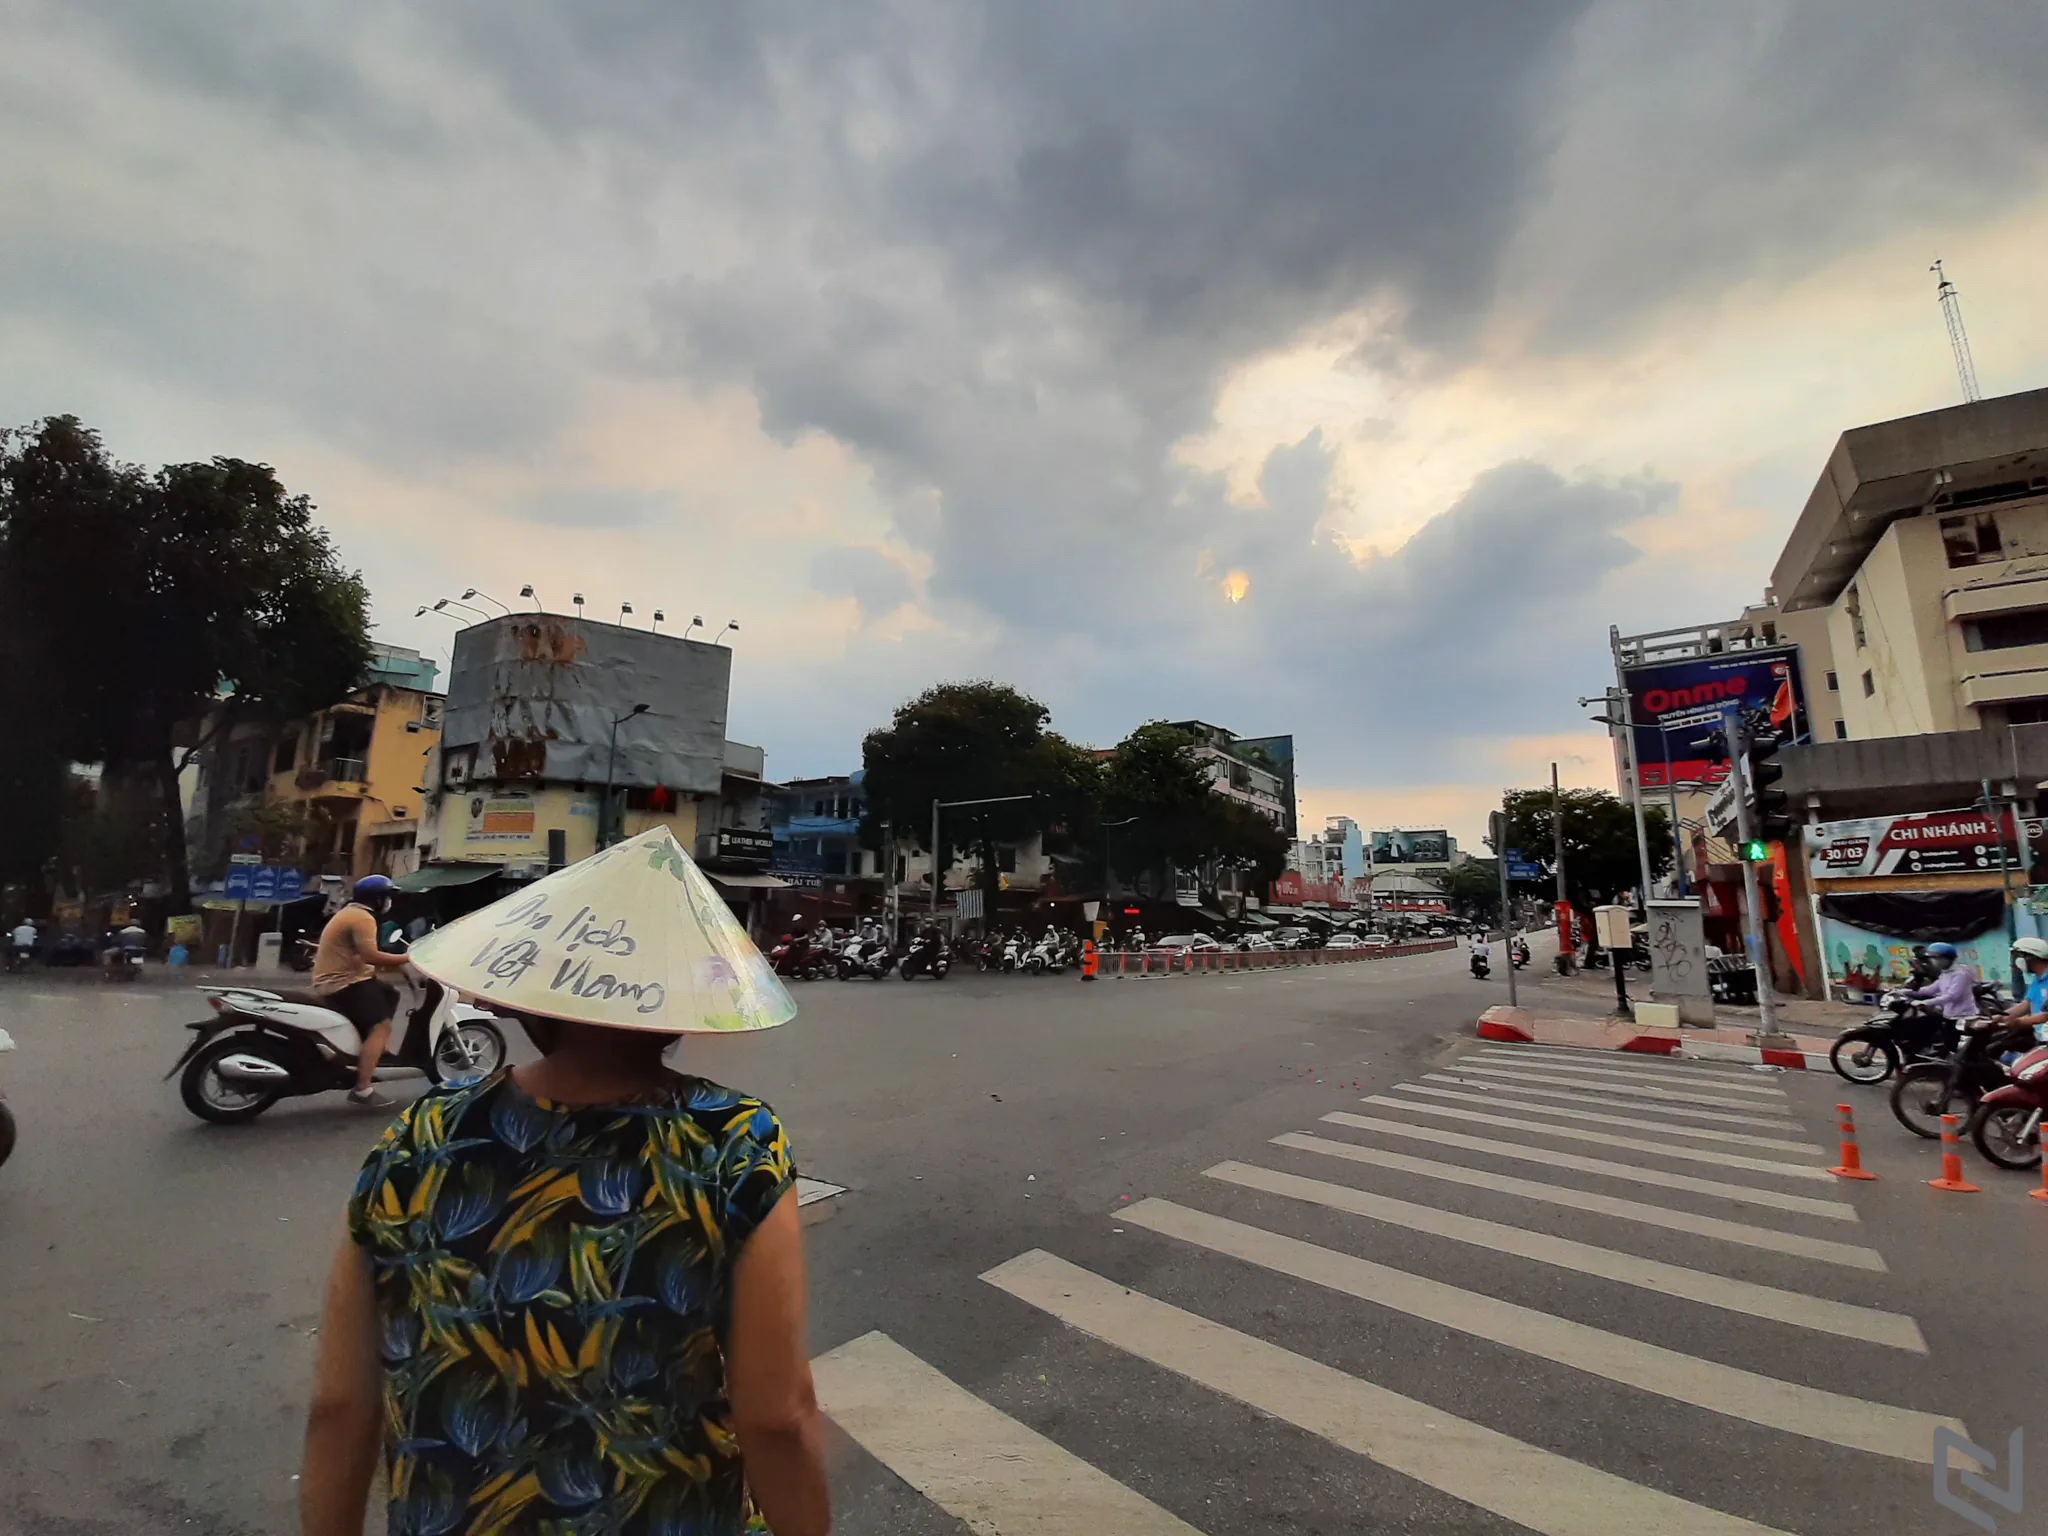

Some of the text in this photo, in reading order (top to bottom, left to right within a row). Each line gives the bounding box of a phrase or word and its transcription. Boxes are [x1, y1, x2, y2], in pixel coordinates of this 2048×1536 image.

[1643, 676, 1747, 712] Onme
[1890, 828, 1919, 841] CHI
[1921, 822, 1987, 838] NHÁNH
[731, 837, 753, 846] LEATHER
[755, 839, 773, 848] WORLD
